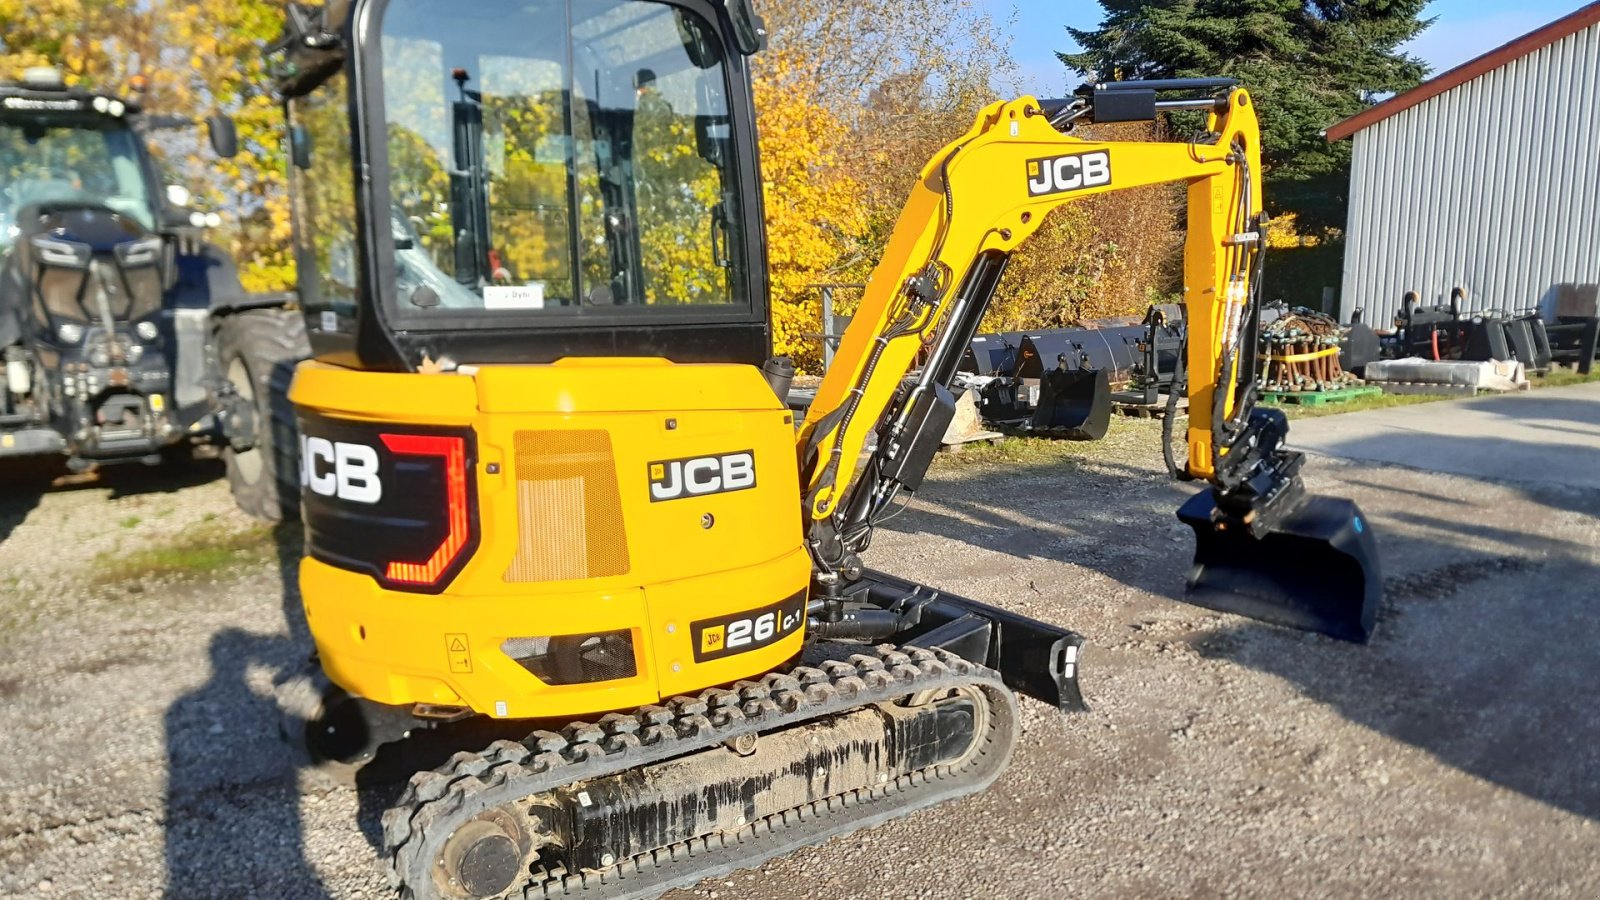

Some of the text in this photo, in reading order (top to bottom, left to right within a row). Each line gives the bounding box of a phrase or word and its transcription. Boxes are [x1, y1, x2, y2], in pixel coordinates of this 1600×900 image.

[1029, 152, 1110, 194] JCB
[652, 453, 755, 498] JCB
[727, 612, 775, 648] 26
